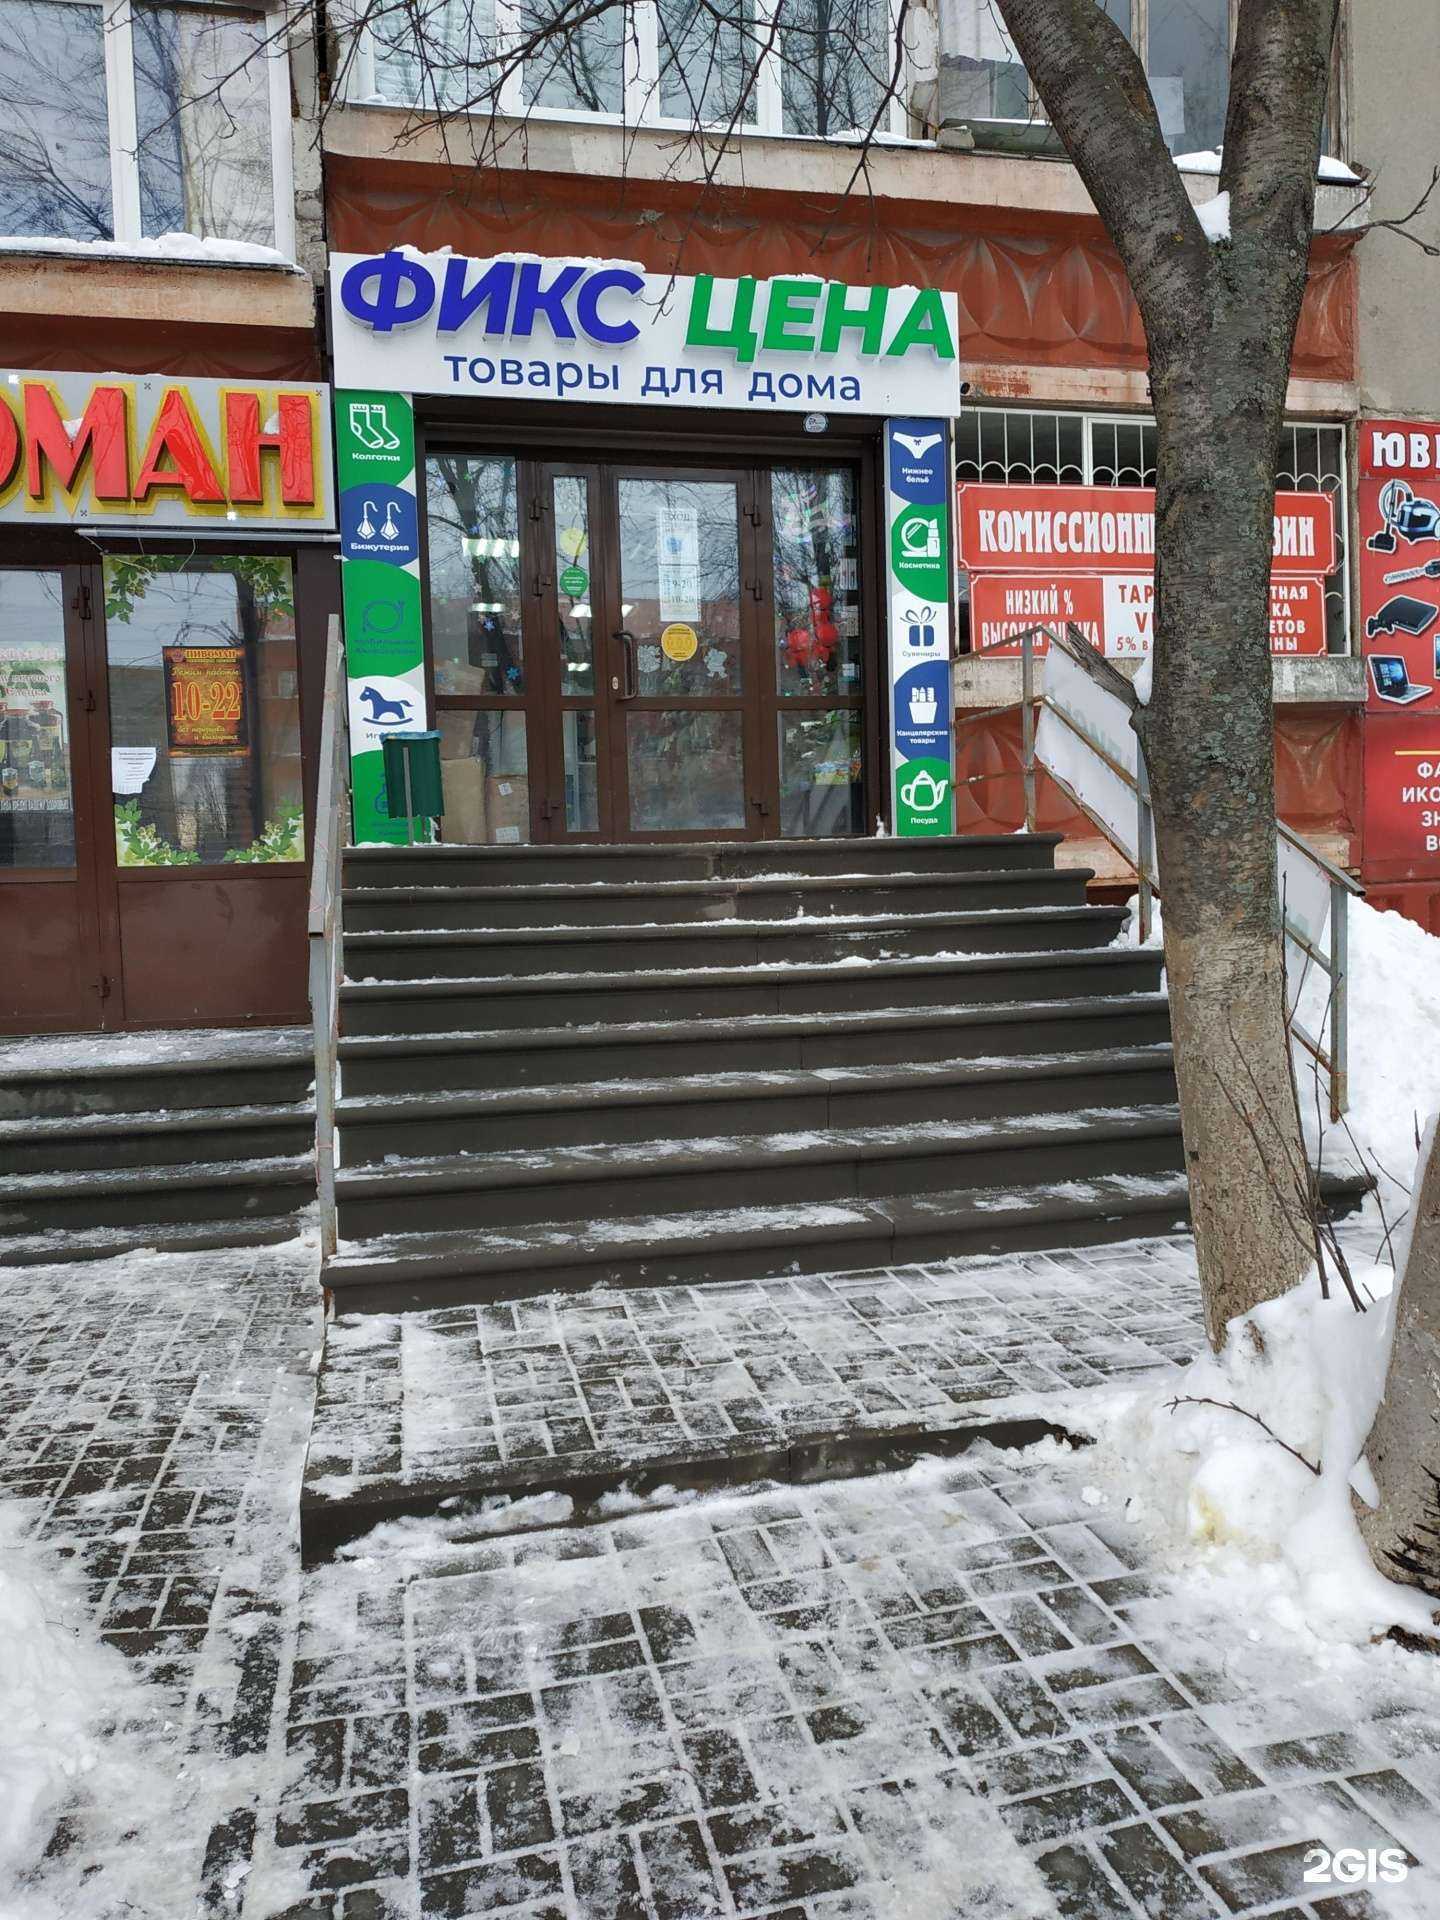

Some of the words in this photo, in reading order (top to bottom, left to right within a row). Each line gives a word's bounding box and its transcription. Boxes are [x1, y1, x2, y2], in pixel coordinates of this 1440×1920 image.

[340, 251, 646, 345] ФИКС
[684, 274, 957, 364] ЦЕНА
[443, 354, 620, 394] товары
[641, 365, 723, 400] для
[748, 368, 861, 404] дома
[0, 384, 316, 505] МАН
[352, 453, 400, 461] Колготки
[902, 467, 933, 475] Нижнее
[979, 509, 1155, 554] КОМИССИОНН
[350, 542, 410, 552] Бижутерия
[899, 561, 940, 569] Косметика
[1006, 584, 1058, 615] НИЗКИЙ
[1063, 589, 1073, 615] %
[1134, 611, 1154, 633] V
[1117, 636, 1136, 651] 5%
[1269, 637, 1298, 651] НЫ
[173, 681, 241, 721] 10-22
[909, 737, 936, 745] товары
[910, 816, 938, 825] Посуда
[1426, 835, 1440, 851] В
